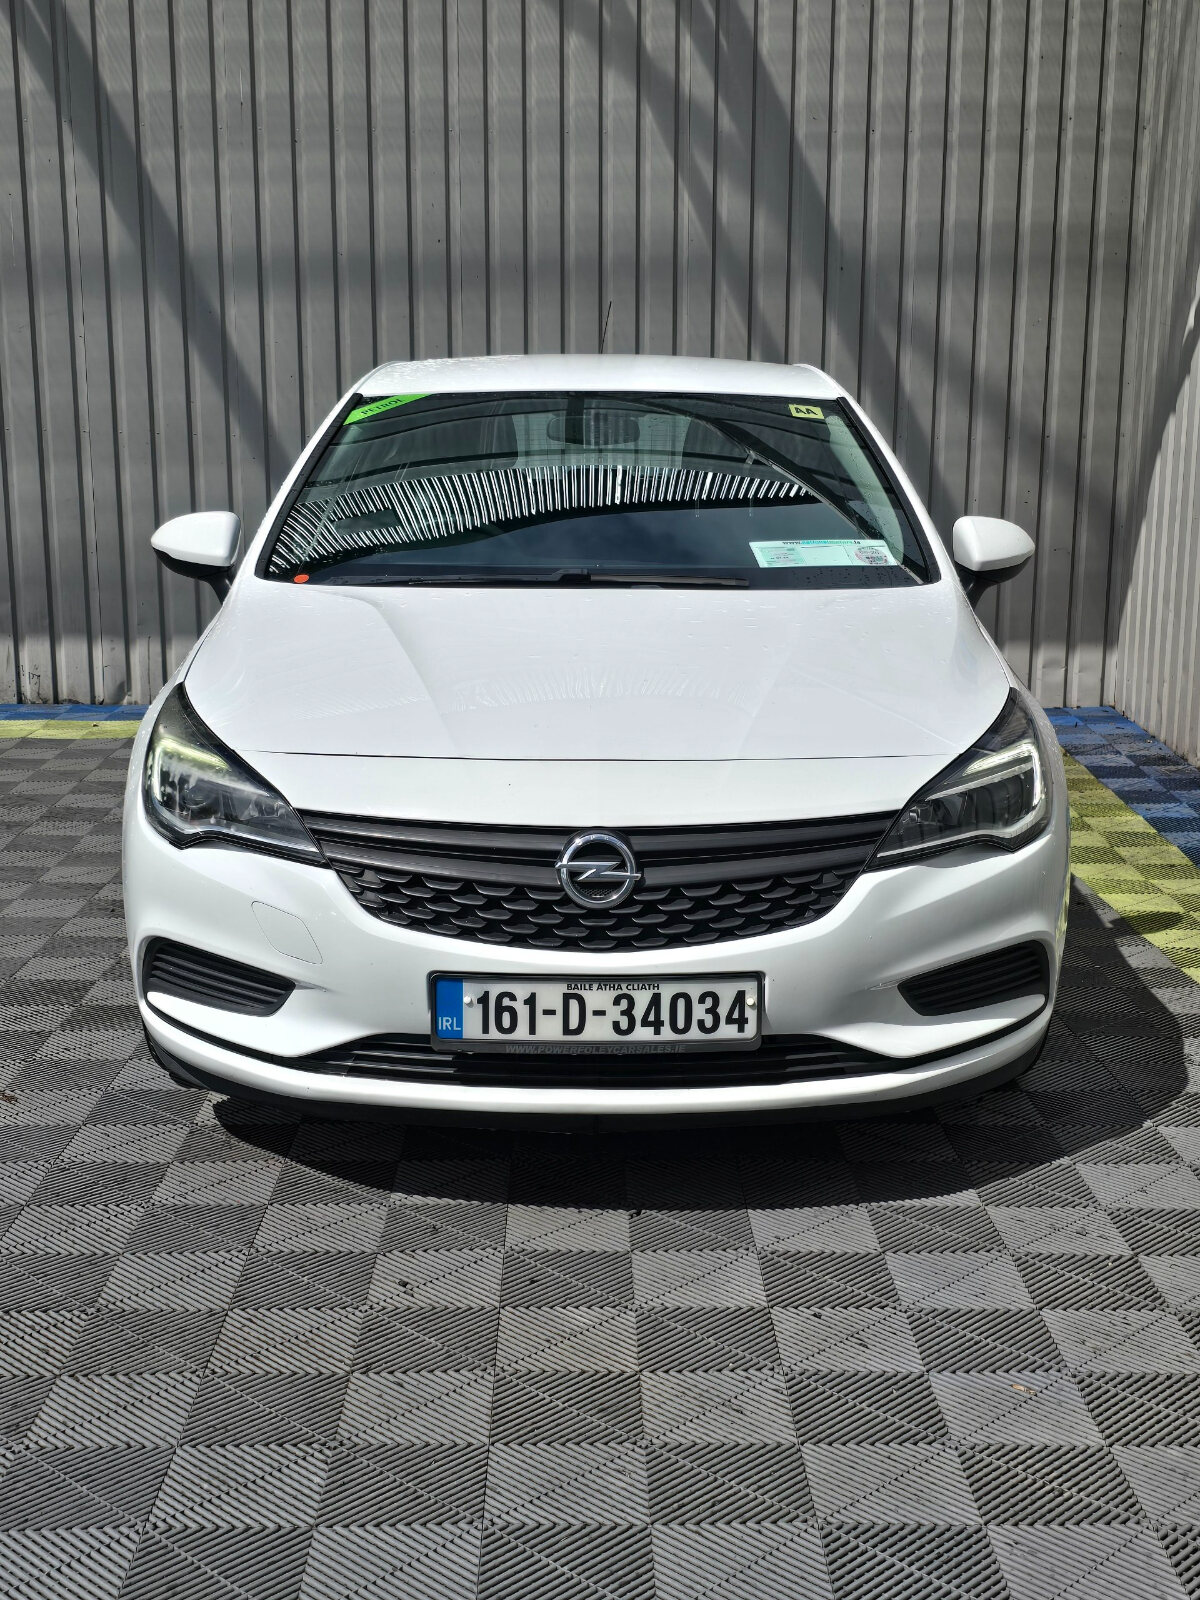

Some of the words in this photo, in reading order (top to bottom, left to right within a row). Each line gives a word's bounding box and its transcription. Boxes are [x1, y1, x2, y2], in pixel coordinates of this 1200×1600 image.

[794, 406, 819, 416] AA
[566, 983, 594, 991] BAILE
[625, 983, 660, 991] CLIATH
[476, 990, 749, 1036] 161-D-34034
[438, 1016, 462, 1031] IRL
[505, 1045, 686, 1054] WWW.POWERFOLEYCARSALES.IE
